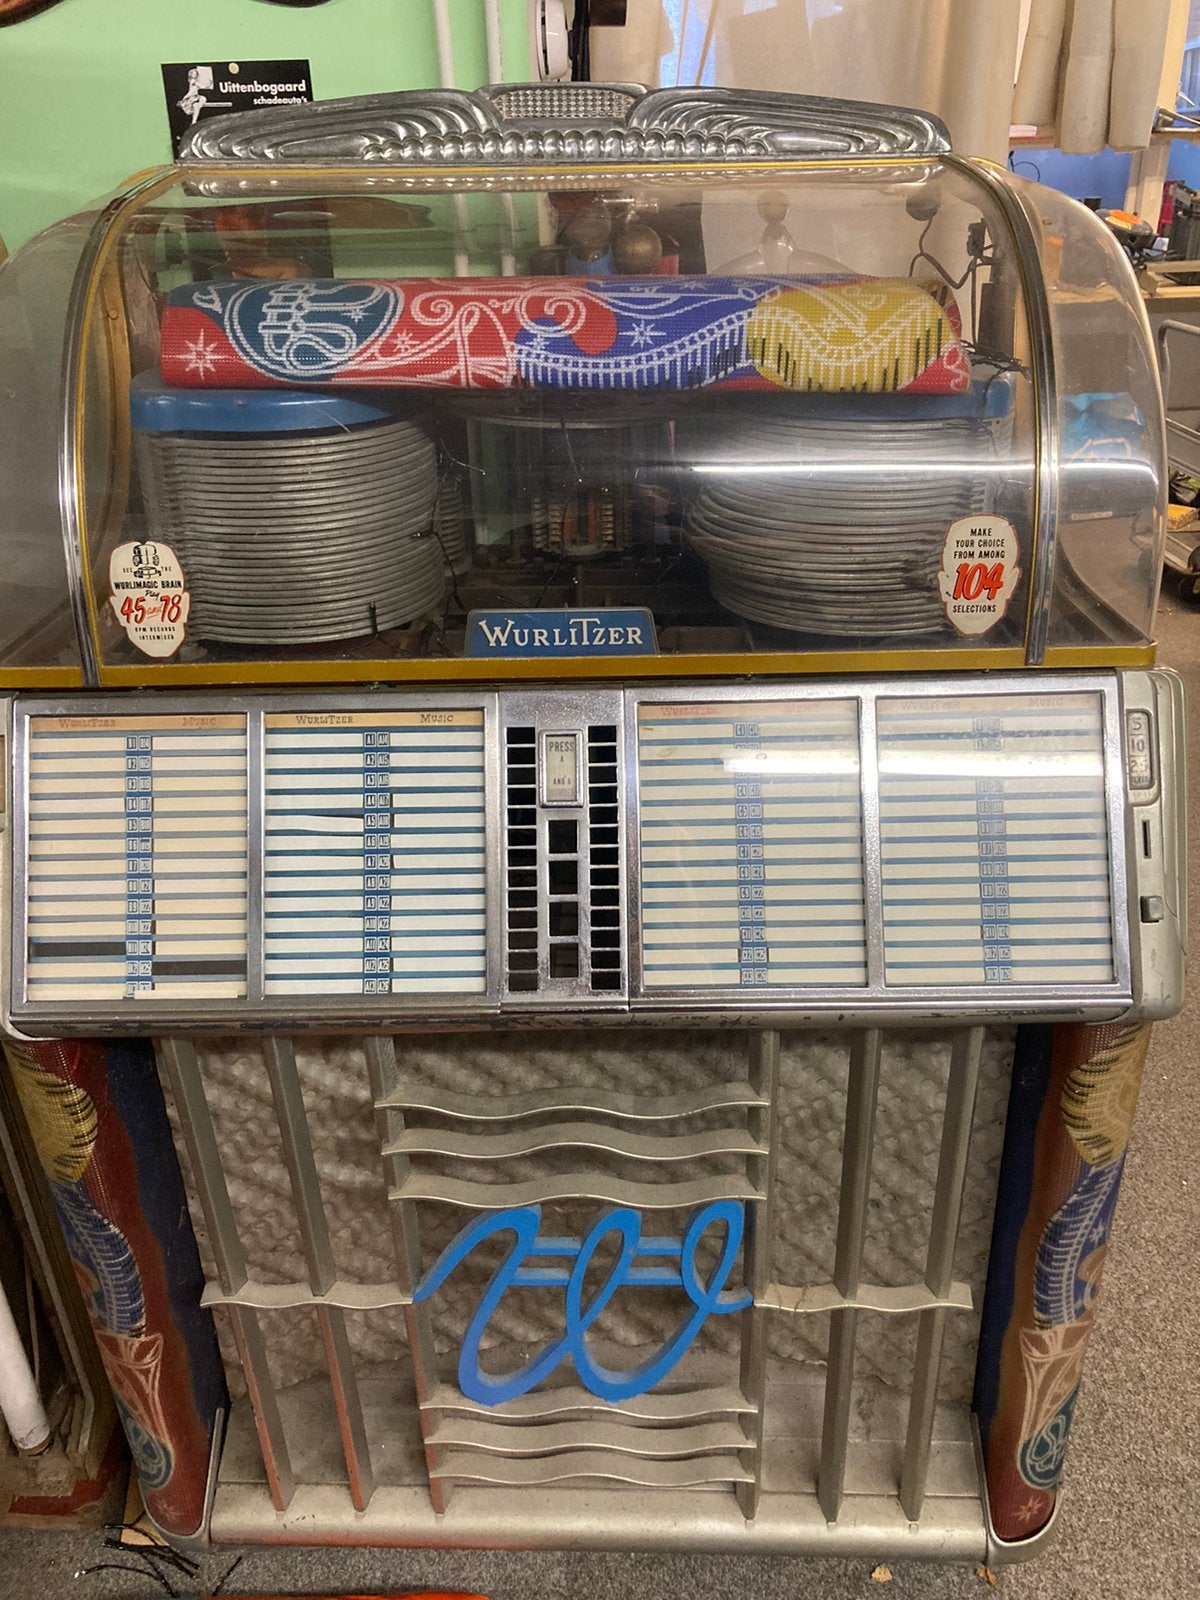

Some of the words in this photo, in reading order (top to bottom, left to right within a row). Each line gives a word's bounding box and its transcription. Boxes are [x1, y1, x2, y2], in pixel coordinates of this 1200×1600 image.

[218, 79, 306, 94] Uittenbogaard
[253, 96, 308, 105] schadeauto's
[970, 528, 992, 536] MAKE
[978, 539, 1005, 548] CHOICE
[954, 551, 974, 559] FROM
[978, 550, 1005, 558] AMONG
[114, 581, 158, 590] WURLIMAGIC
[161, 580, 182, 588] BRAIN
[953, 562, 1005, 600] 104
[145, 590, 160, 600] Play
[120, 596, 146, 624] 45
[160, 594, 182, 623] 78
[952, 604, 996, 613] SELECTIONS
[478, 618, 642, 647] WURLITZER
[296, 715, 354, 724] WURLITZER
[420, 714, 454, 723] MUSIC
[1132, 717, 1142, 730] 5
[549, 741, 574, 752] PRESS
[1131, 739, 1144, 752] 10
